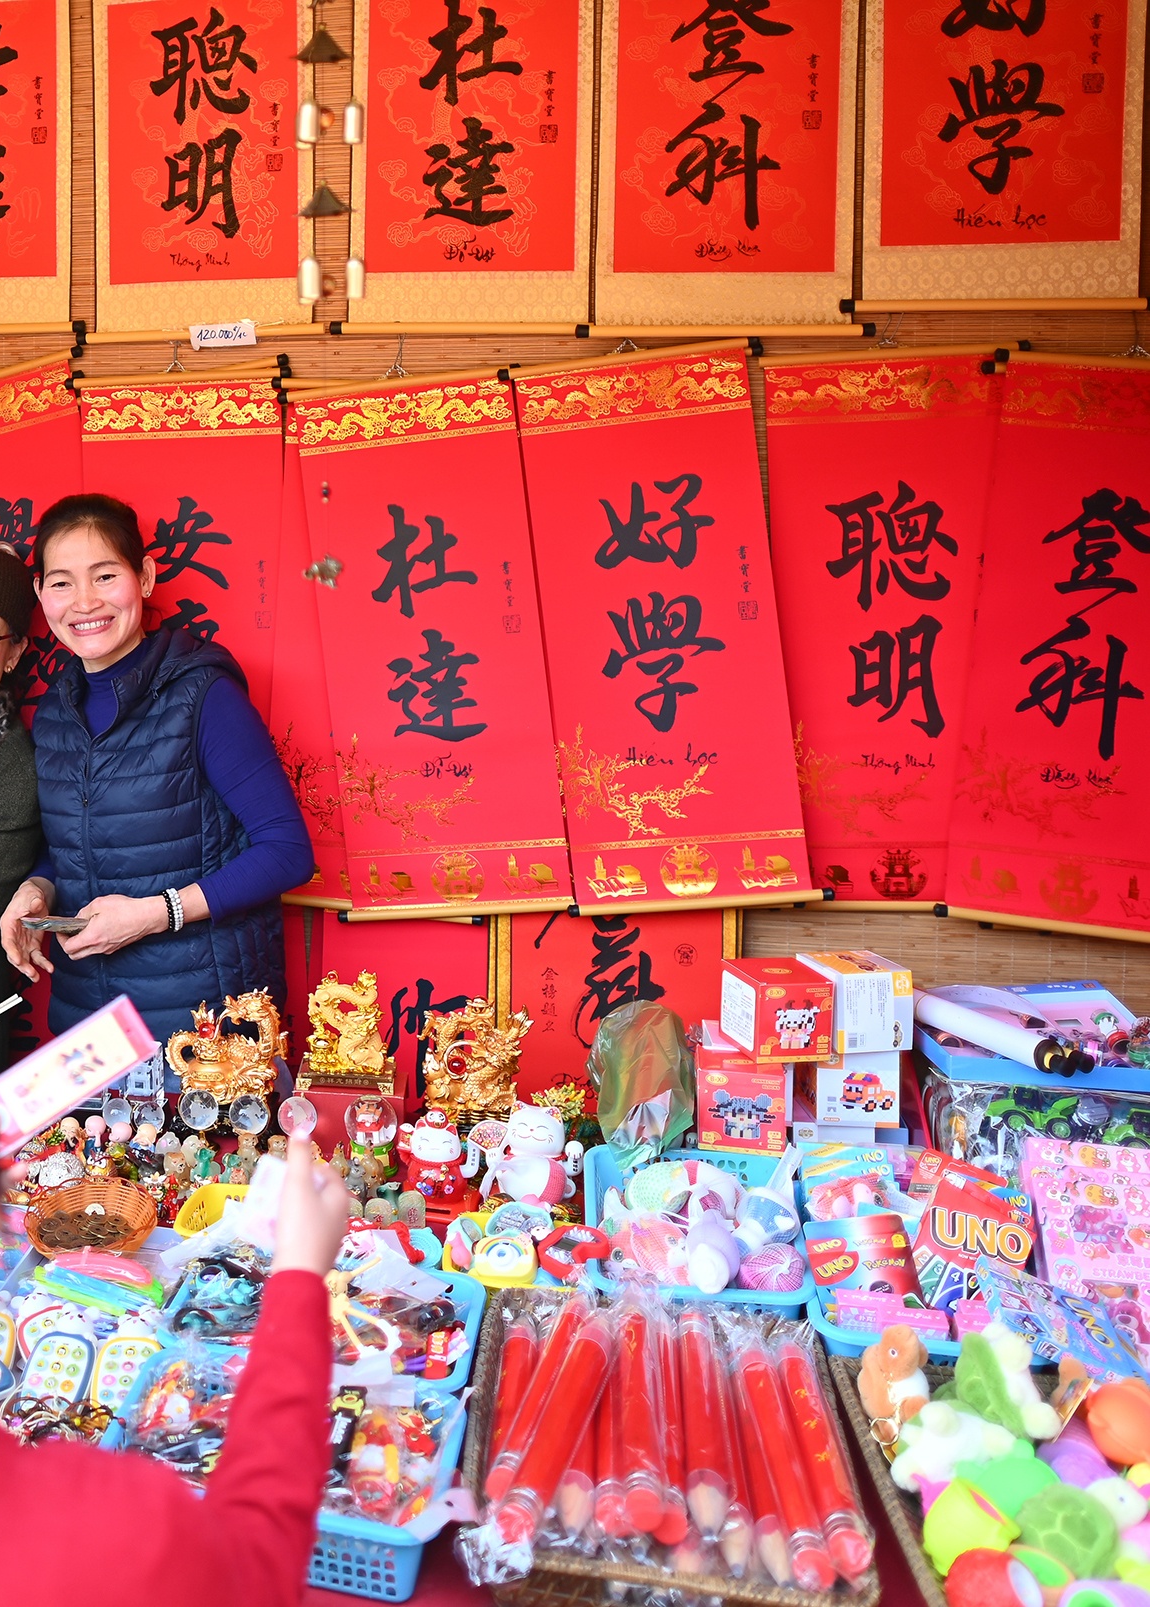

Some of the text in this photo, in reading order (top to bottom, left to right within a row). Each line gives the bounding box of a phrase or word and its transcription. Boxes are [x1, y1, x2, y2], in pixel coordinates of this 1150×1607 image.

[150, 8, 258, 239] 聰明
[420, 0, 523, 227] 杜達
[372, 504, 488, 743] 杜達
[595, 474, 726, 733] 好學
[826, 481, 958, 738] 聰明
[812, 1239, 842, 1253] UNO
[815, 1255, 854, 1278] UNO
[931, 1206, 1033, 1265] UNO
[950, 1272, 960, 1282] 4
[1060, 1294, 1116, 1349] UNO
